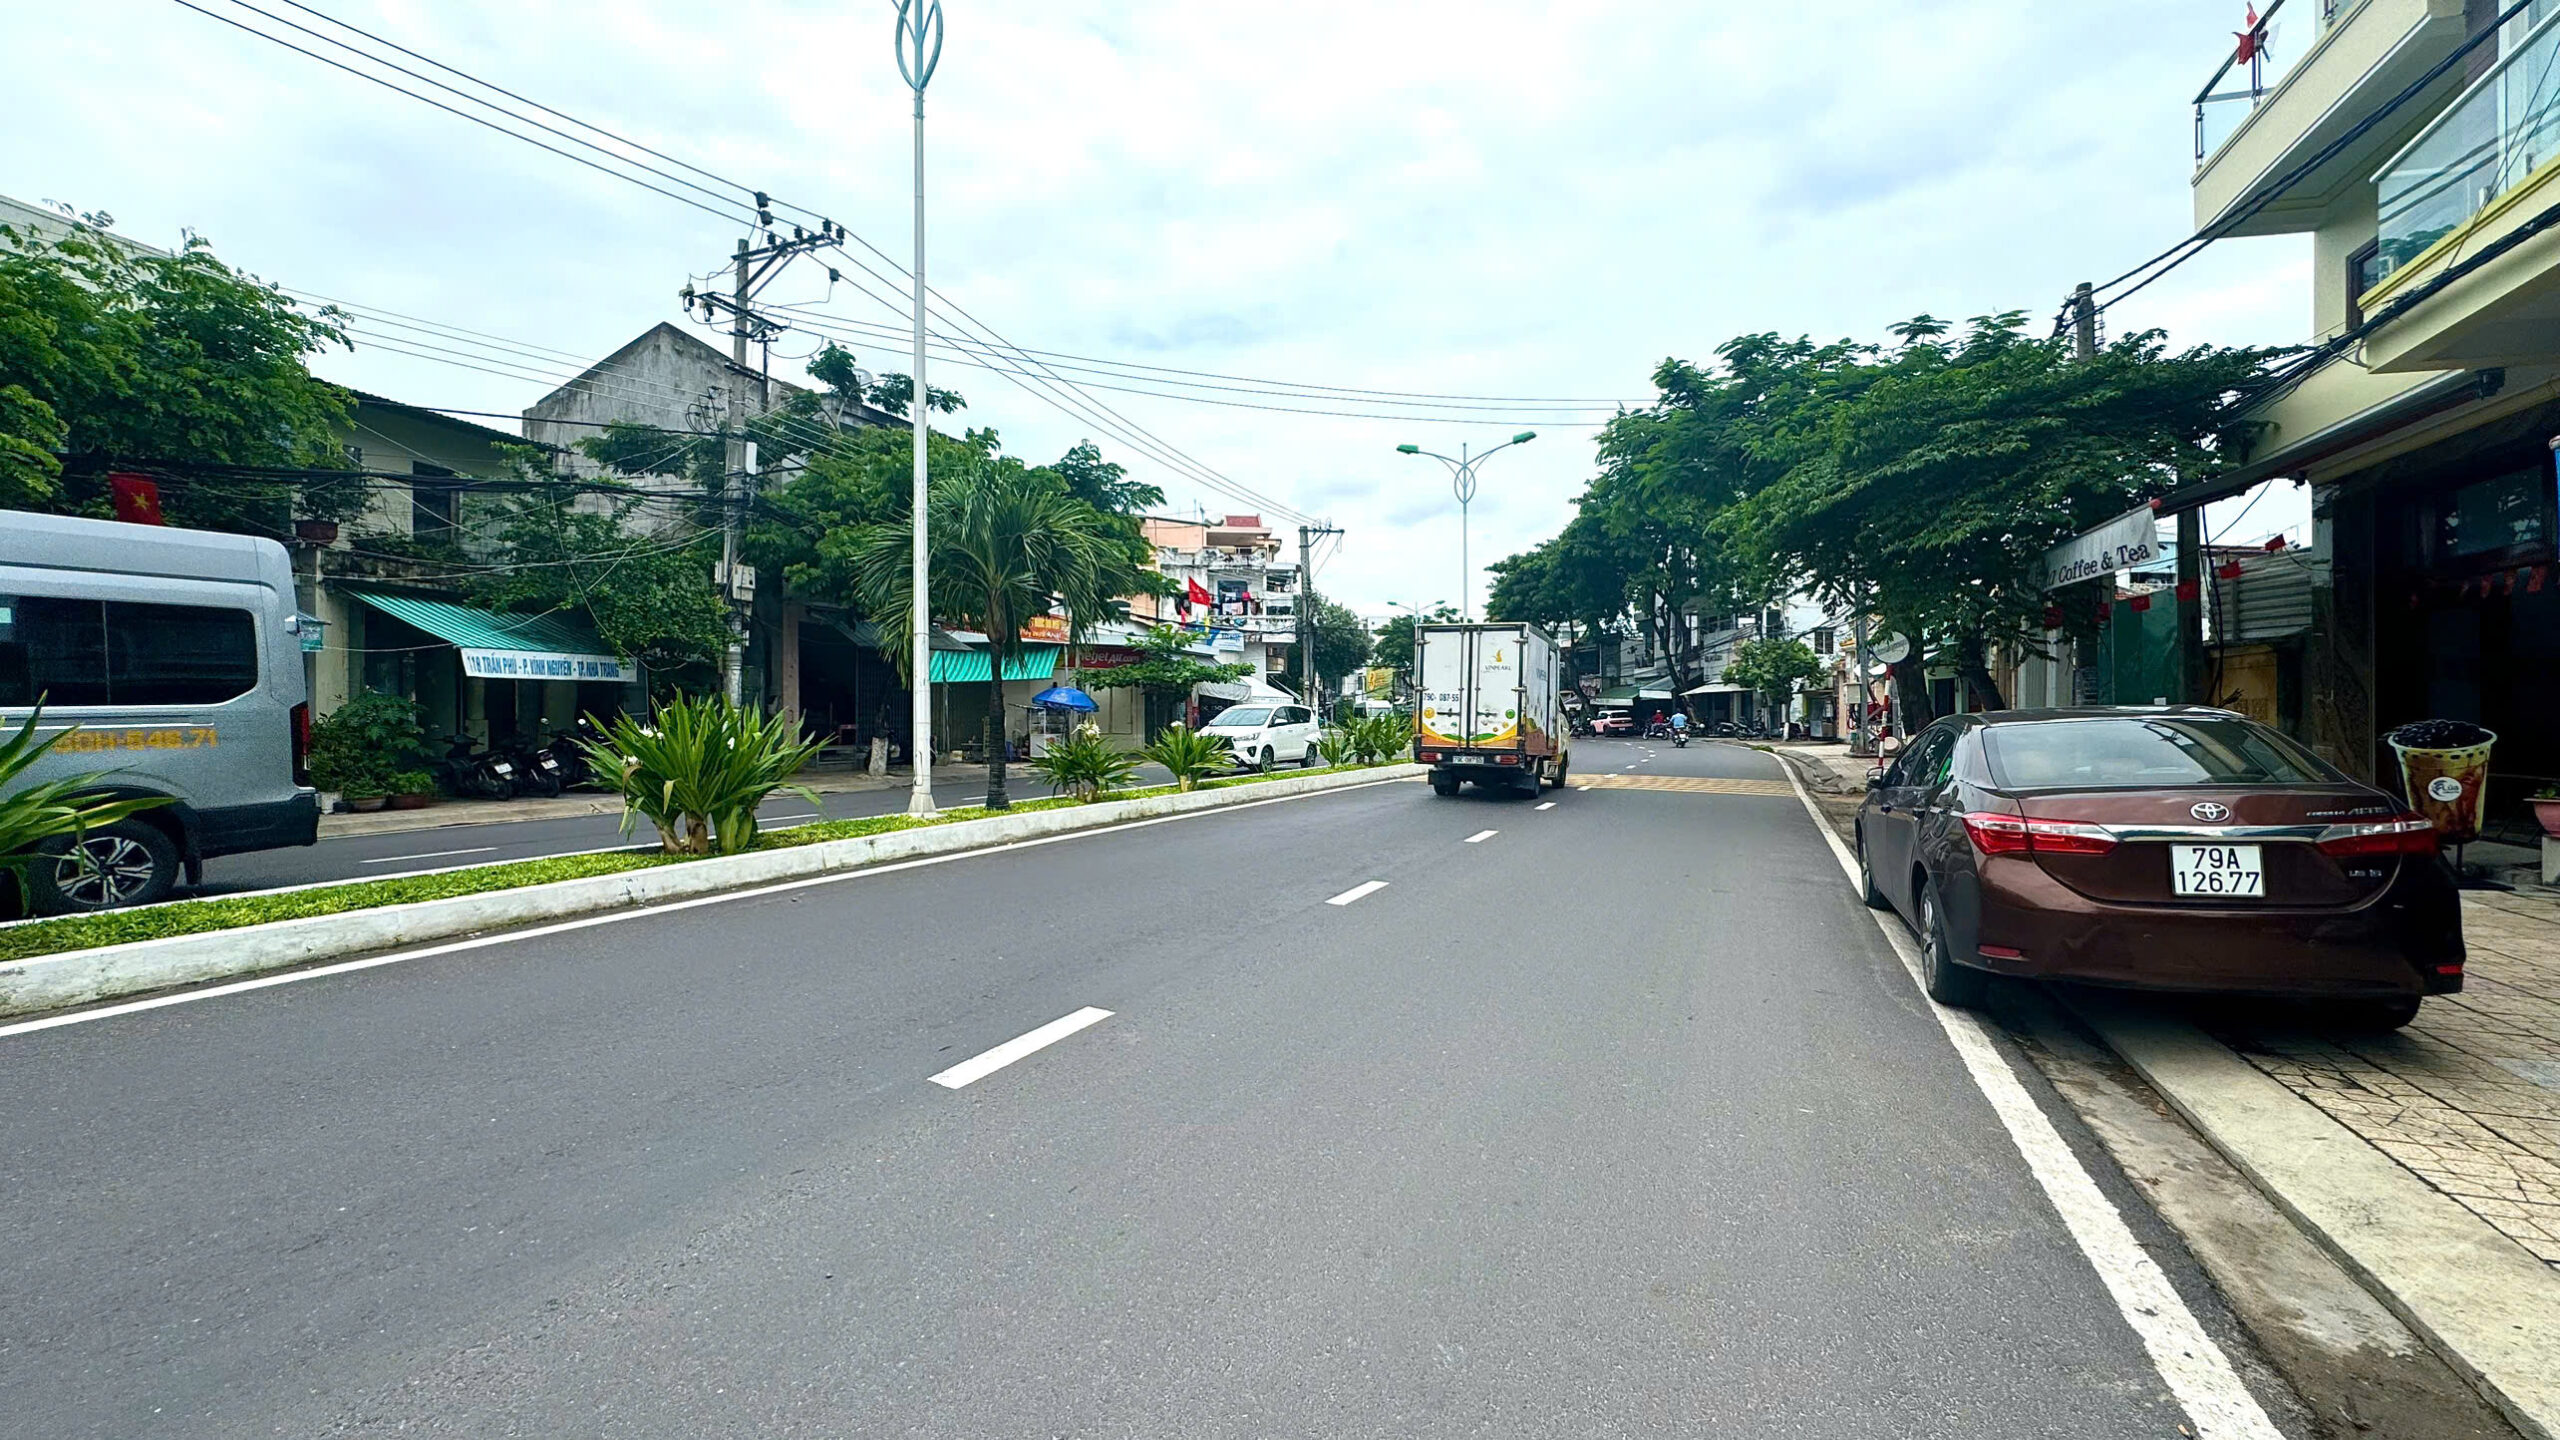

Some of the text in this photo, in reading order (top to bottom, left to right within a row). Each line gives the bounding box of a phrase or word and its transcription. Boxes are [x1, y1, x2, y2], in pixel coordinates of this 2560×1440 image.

[2058, 559, 2097, 583] Coffee
[2101, 551, 2113, 571] &
[2116, 543, 2150, 565] Tea
[2192, 847, 2240, 869] 79A
[2178, 871, 2260, 893] 126.77
